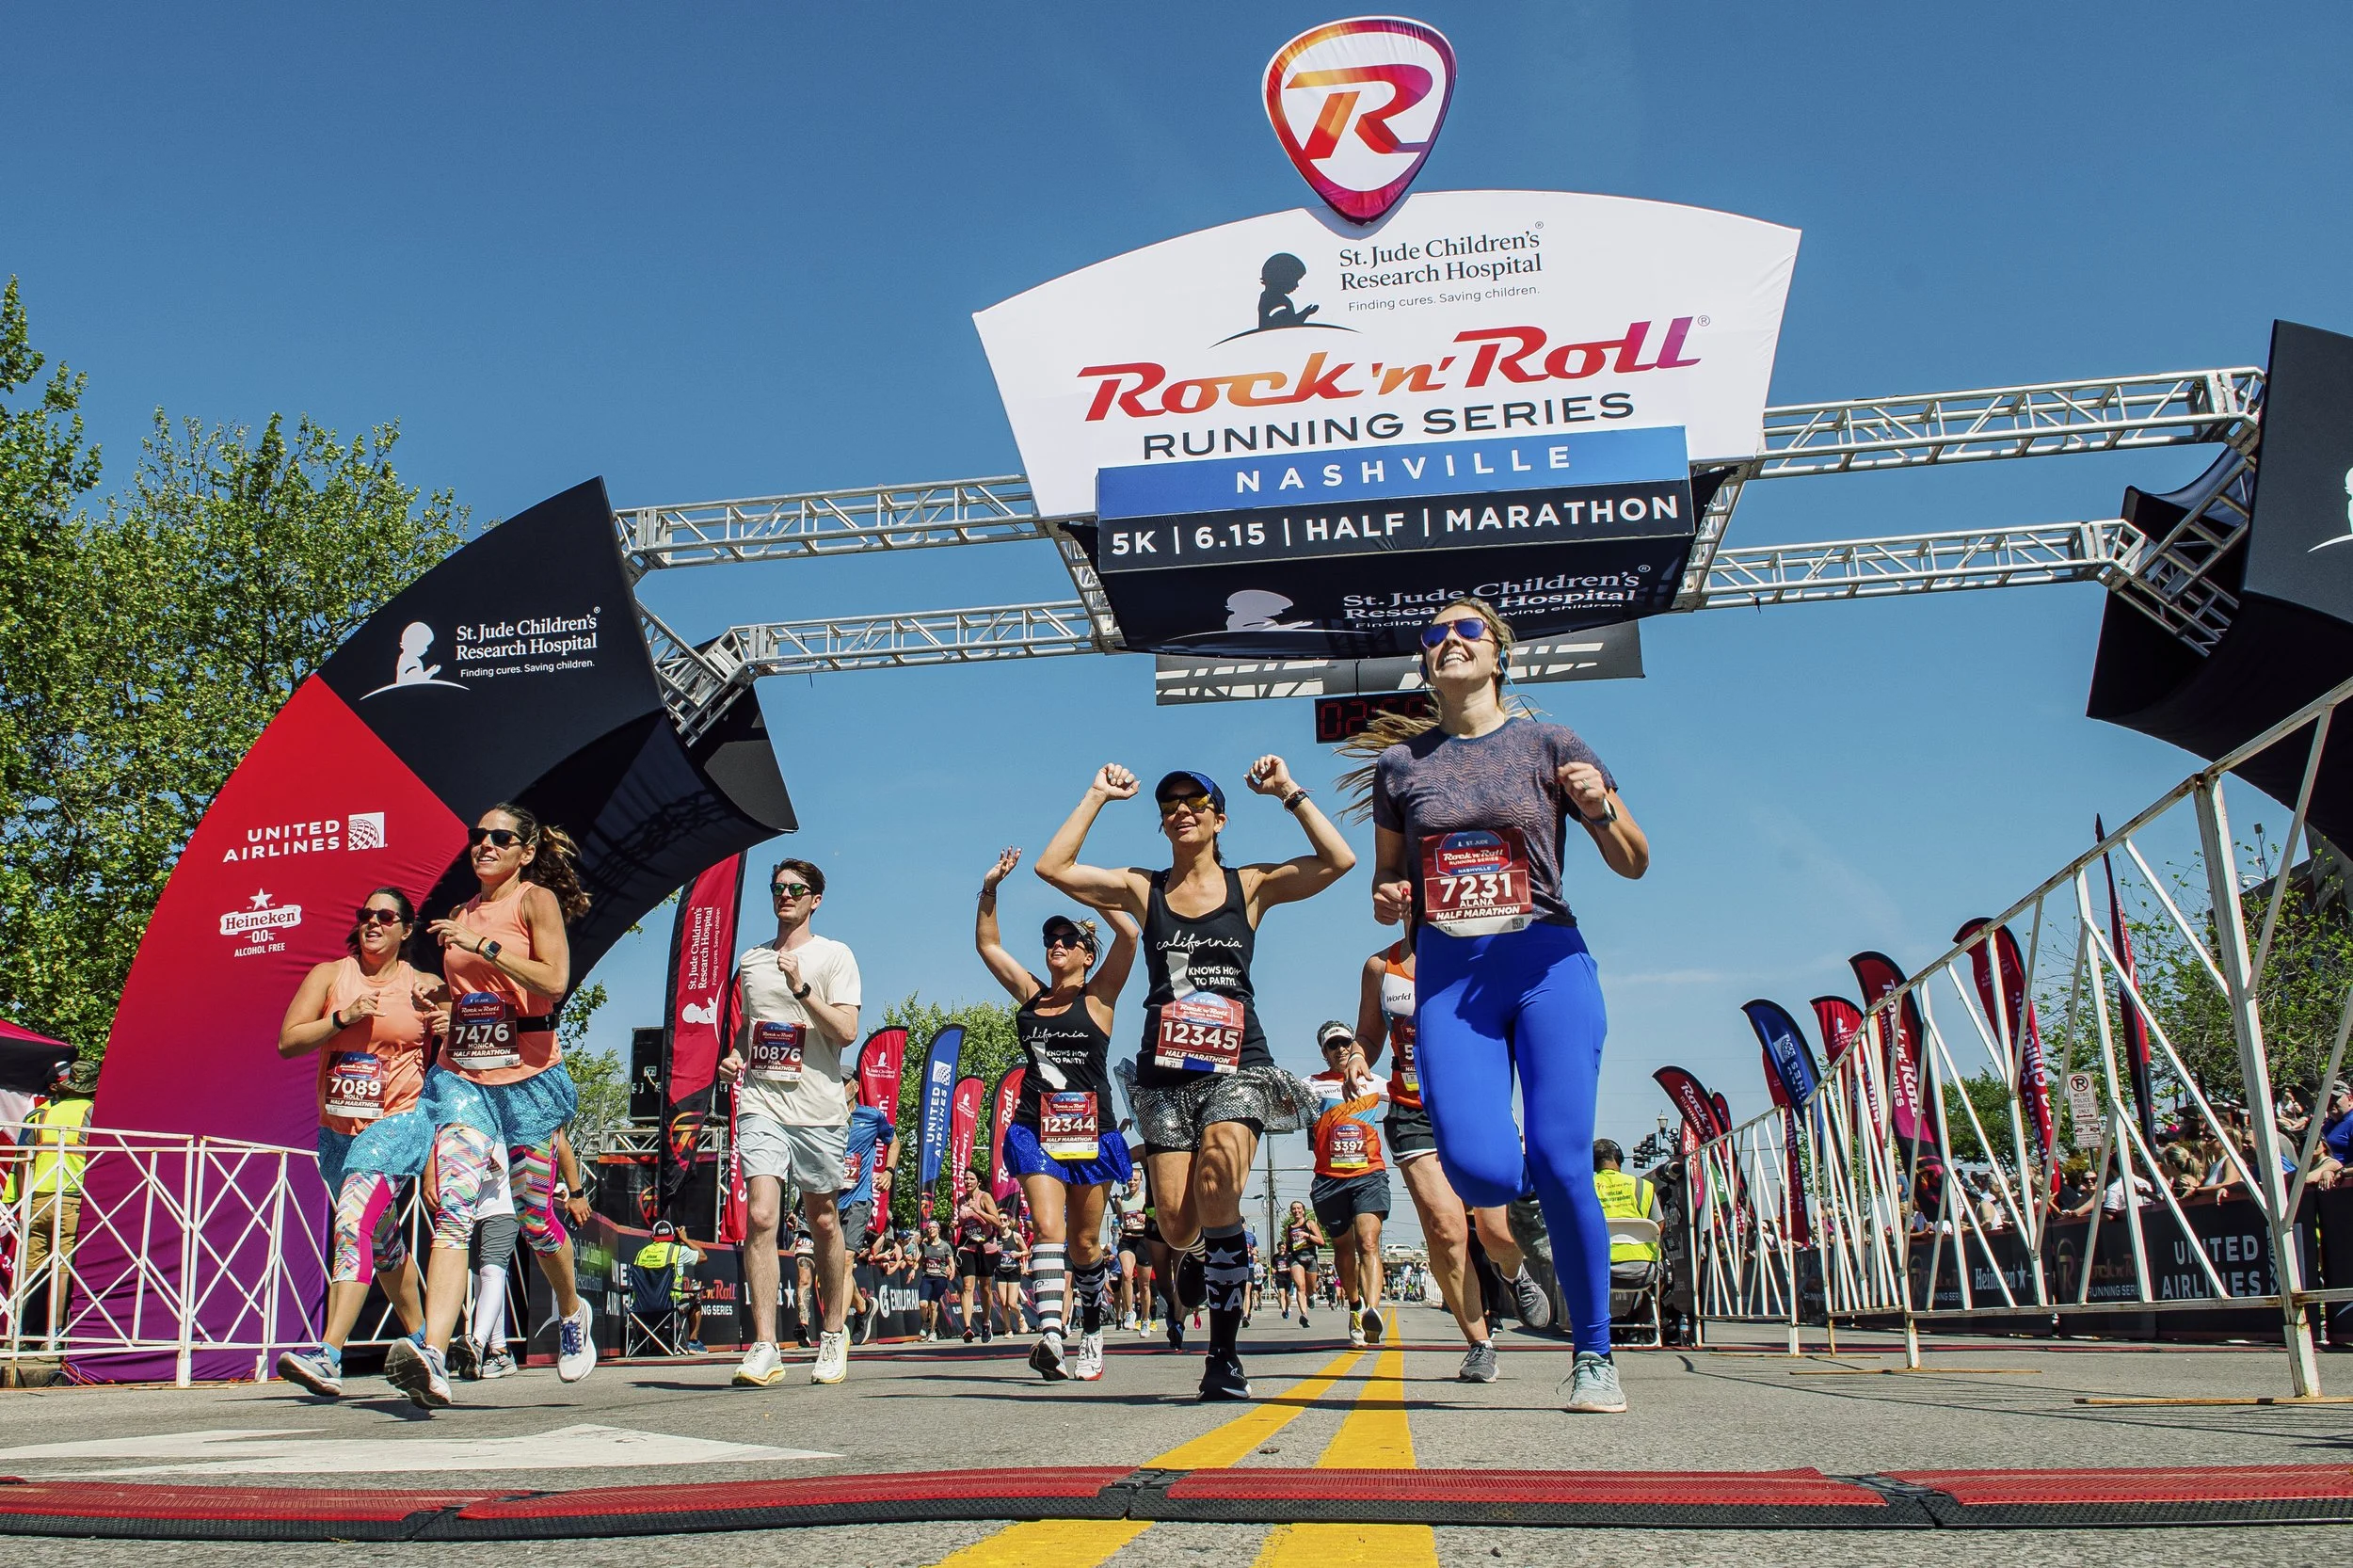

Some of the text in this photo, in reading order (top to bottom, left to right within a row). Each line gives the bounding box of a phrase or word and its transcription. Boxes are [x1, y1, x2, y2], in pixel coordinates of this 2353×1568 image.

[1339, 231, 1540, 269] St. Jude Children's
[1340, 252, 1543, 291] Research Hospital
[1349, 285, 1540, 312] Finding cures. Saving children.
[1077, 351, 1364, 422] Rock
[1453, 315, 1702, 388] Roll
[1144, 392, 1634, 460] RUNNING SERIES
[1236, 445, 1570, 494] NASHVILLE
[1112, 495, 1678, 556] 5K 6.15 HALF MARATHON
[1343, 571, 1641, 608] St. Jude Children's
[1345, 589, 1636, 620] Resea Hospital
[456, 614, 597, 644] St. Jude Children's
[1355, 619, 1422, 629] Finding
[1496, 607, 1545, 618] aving
[456, 632, 598, 661] Research Hospital
[460, 660, 595, 678] Finding cures. Saving children.
[248, 820, 341, 842] UNITED
[223, 836, 340, 863] AIRLINES
[1443, 849, 1504, 861] Rock Roll
[1440, 872, 1513, 903] 7231
[1436, 905, 1520, 920] HALF MARATHON
[1459, 898, 1495, 908] ALANA
[225, 911, 296, 931] Heineken
[234, 943, 285, 958] ALCOHOL FREE
[688, 907, 702, 990] St. Jude Children's
[697, 906, 712, 989] Research Hospital
[1156, 930, 1242, 954] california
[1188, 966, 1221, 976] KNOWS
[1386, 993, 1411, 1003] World
[455, 1023, 509, 1045] 7476
[1022, 1026, 1089, 1043] california
[1163, 1022, 1239, 1050] 12345
[471, 1048, 511, 1057] MARATHON
[753, 1046, 801, 1063] 10876
[1188, 1053, 1231, 1064] MARATHON
[331, 1079, 381, 1096] 7089
[1900, 1061, 1920, 1118] Roll
[926, 1086, 940, 1143] UNITED
[1001, 1087, 1014, 1125] Roll
[1680, 1096, 1705, 1135] RUNNING
[1042, 1117, 1096, 1132] 12344
[1334, 1140, 1365, 1152] 3397
[713, 1279, 737, 1301] Roll
[1975, 1264, 2017, 1290] Heinen
[2162, 1271, 2262, 1299] AIRLINES
[712, 1304, 733, 1316] SERIES
[1205, 1284, 1243, 1311] CA
